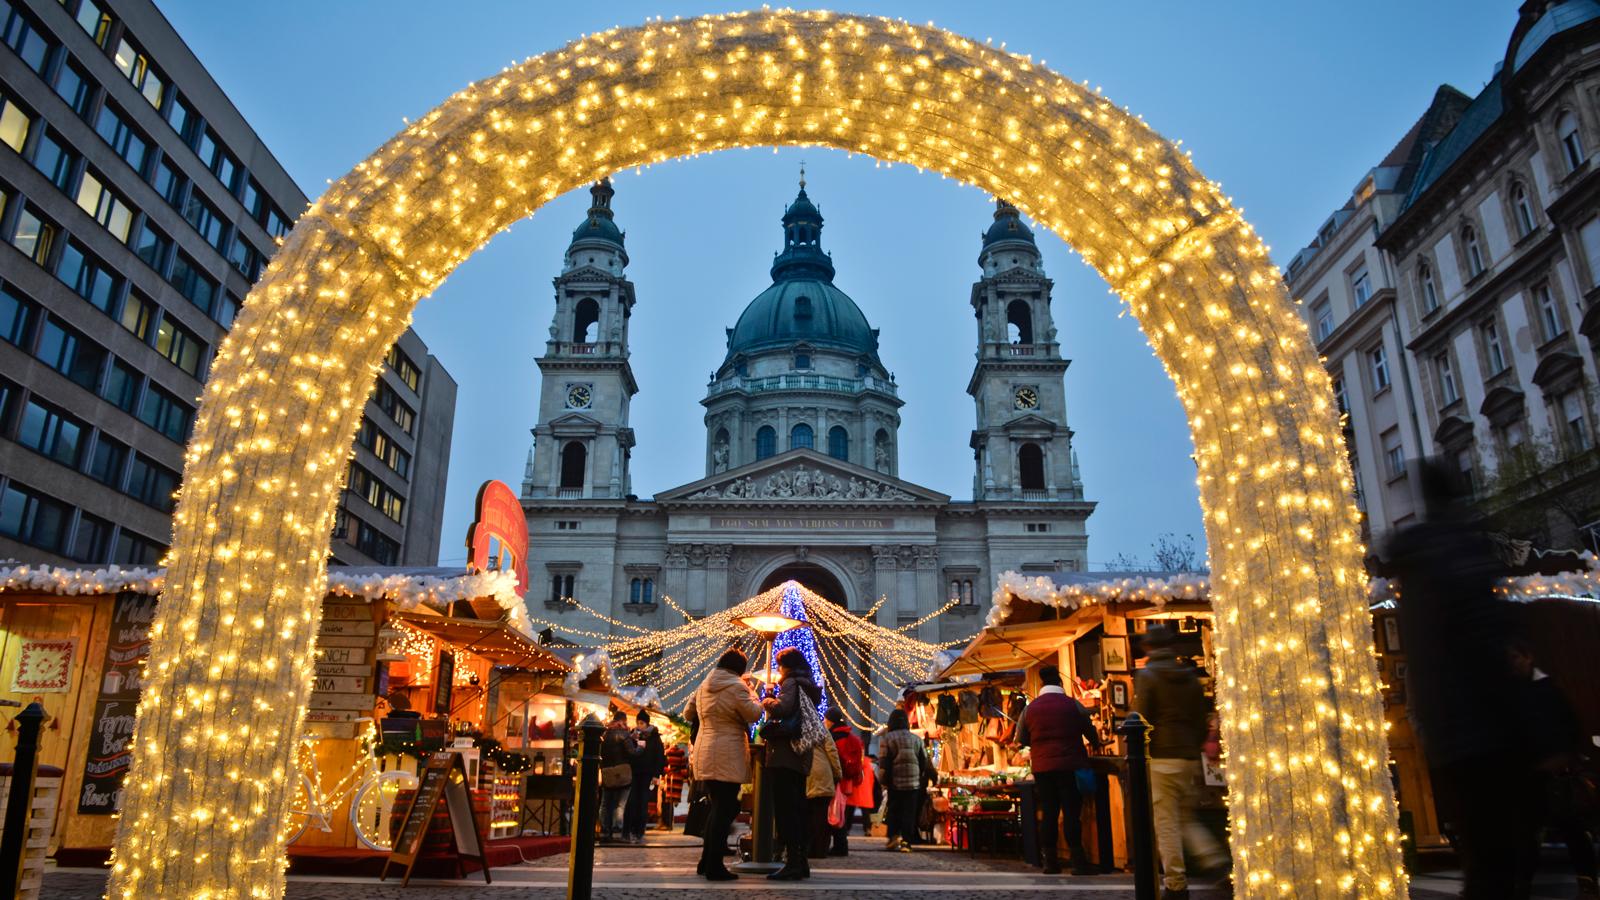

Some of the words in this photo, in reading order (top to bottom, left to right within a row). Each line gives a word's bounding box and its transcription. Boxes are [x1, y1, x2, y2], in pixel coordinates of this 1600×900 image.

[720, 519, 742, 528] EGO
[748, 519, 770, 528] SUM
[776, 519, 793, 528] VIA
[800, 519, 839, 528] VERITAS
[862, 519, 884, 528] VITA
[324, 649, 350, 662] NCH
